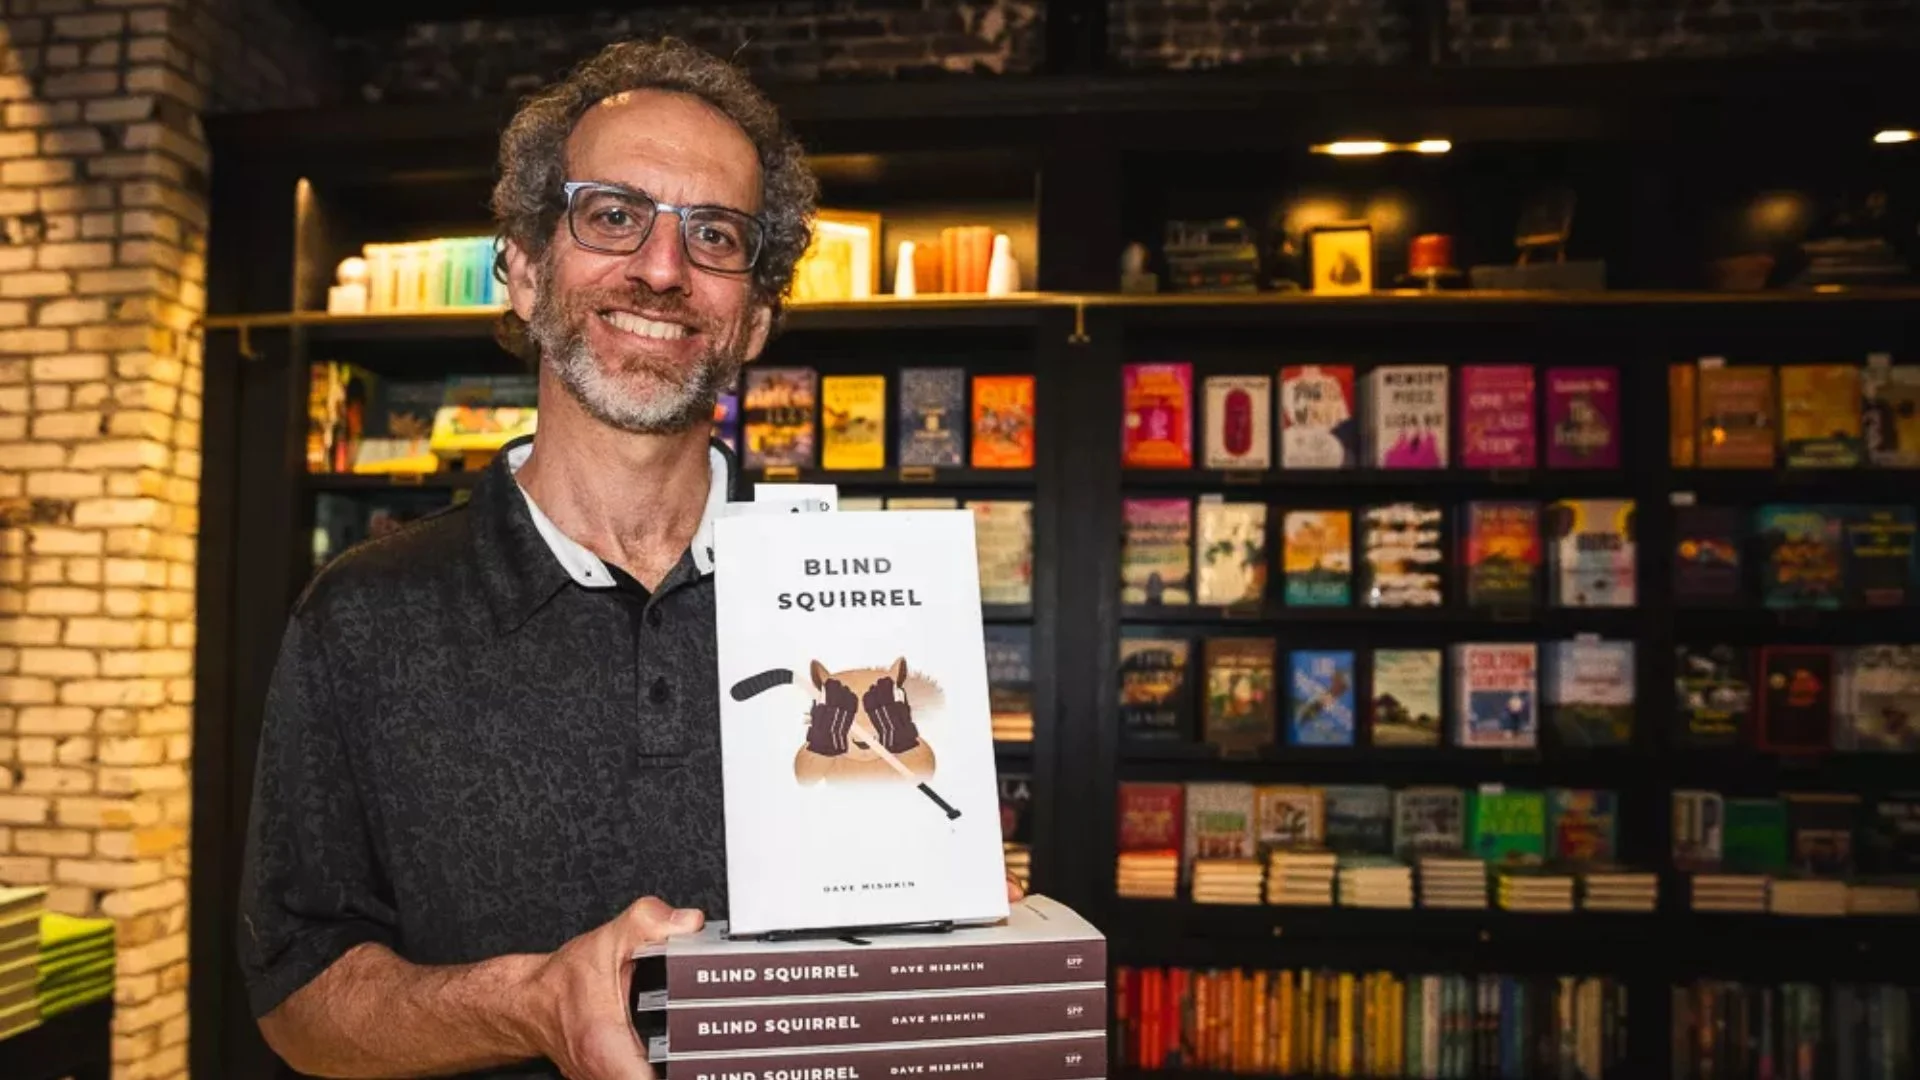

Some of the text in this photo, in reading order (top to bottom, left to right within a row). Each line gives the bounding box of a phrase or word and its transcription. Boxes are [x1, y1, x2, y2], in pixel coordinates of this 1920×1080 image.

[1384, 371, 1445, 385] MEMORY
[804, 557, 892, 576] BLIND
[777, 589, 922, 613] SQUIRREL
[823, 881, 915, 893] DAVE MISHKIN
[697, 963, 860, 983] BLIND SQUIRREL
[890, 962, 985, 975] DAVE MISHKIN
[698, 1015, 861, 1036] BLIND SQUIRREL
[891, 1012, 986, 1025] DAVE MISHKIN
[763, 1066, 860, 1080] SQUIRREL
[890, 1061, 985, 1075] DAVE MISHKIN
